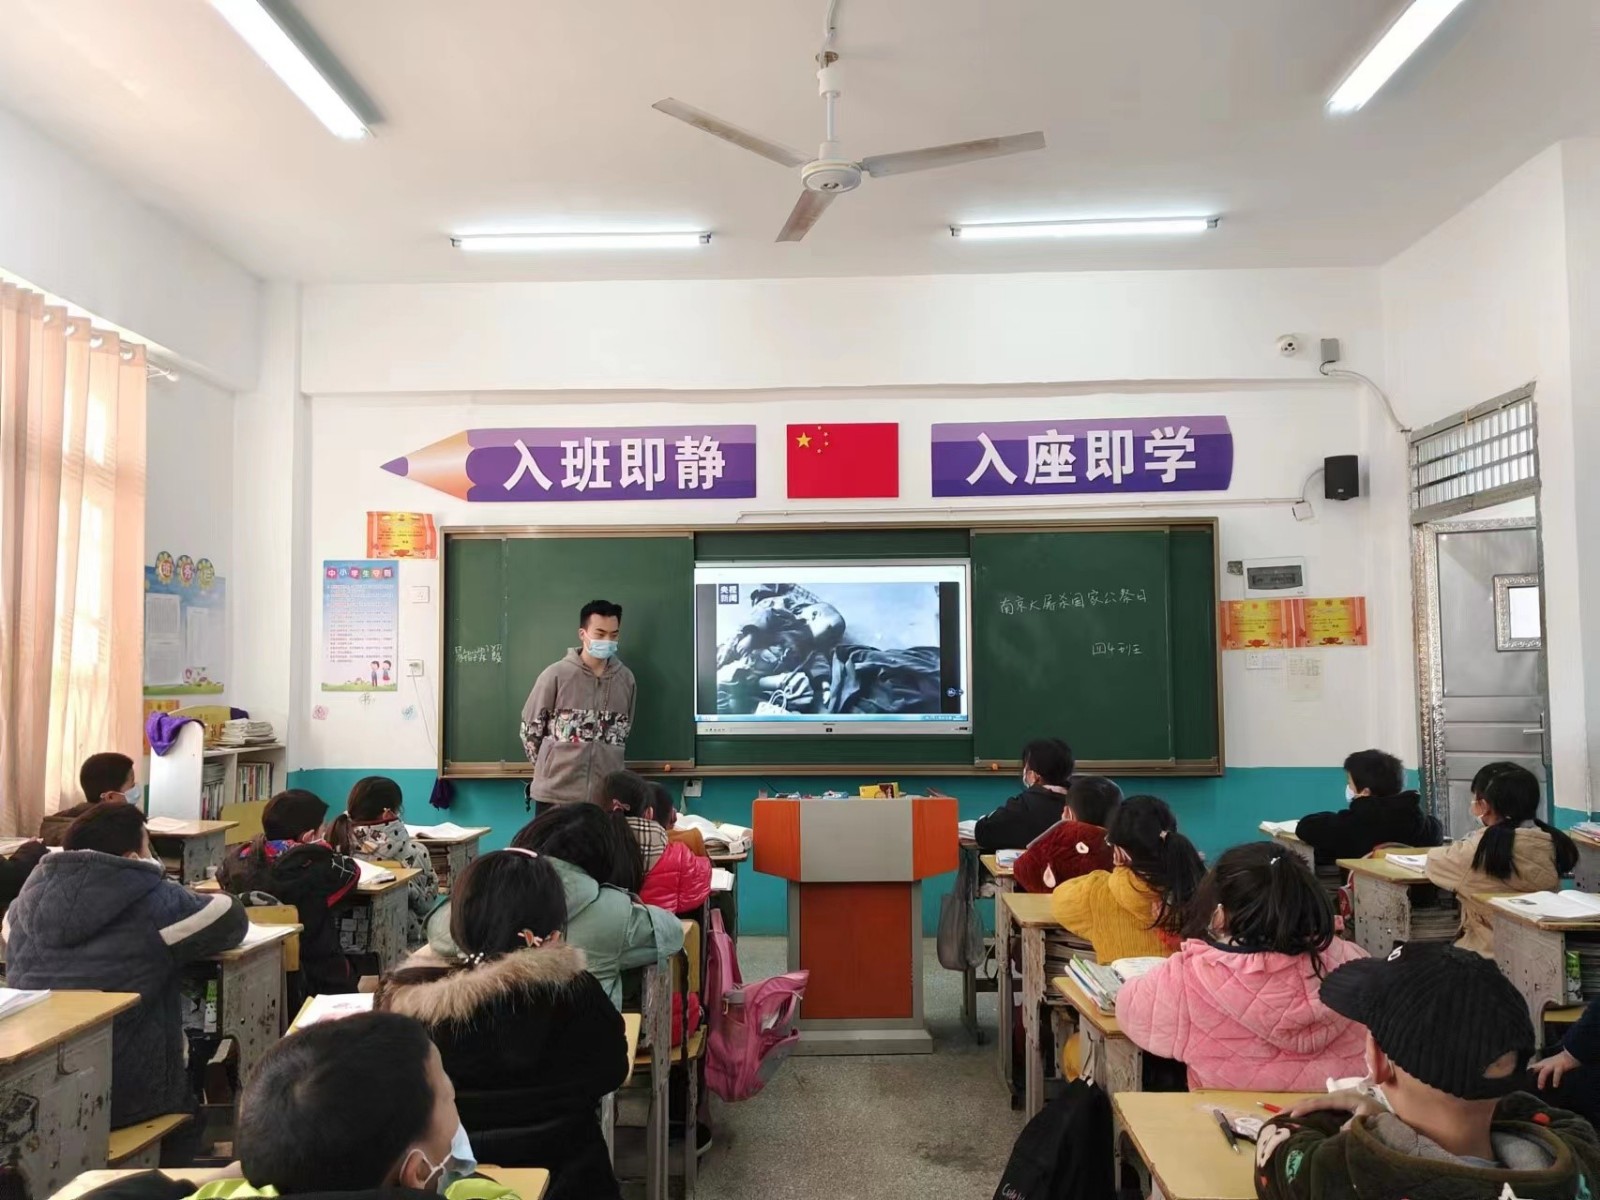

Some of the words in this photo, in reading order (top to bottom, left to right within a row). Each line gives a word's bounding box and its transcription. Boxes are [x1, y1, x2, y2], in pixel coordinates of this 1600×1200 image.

[503, 435, 725, 492] 入班即静
[966, 425, 1196, 485] 入座即学
